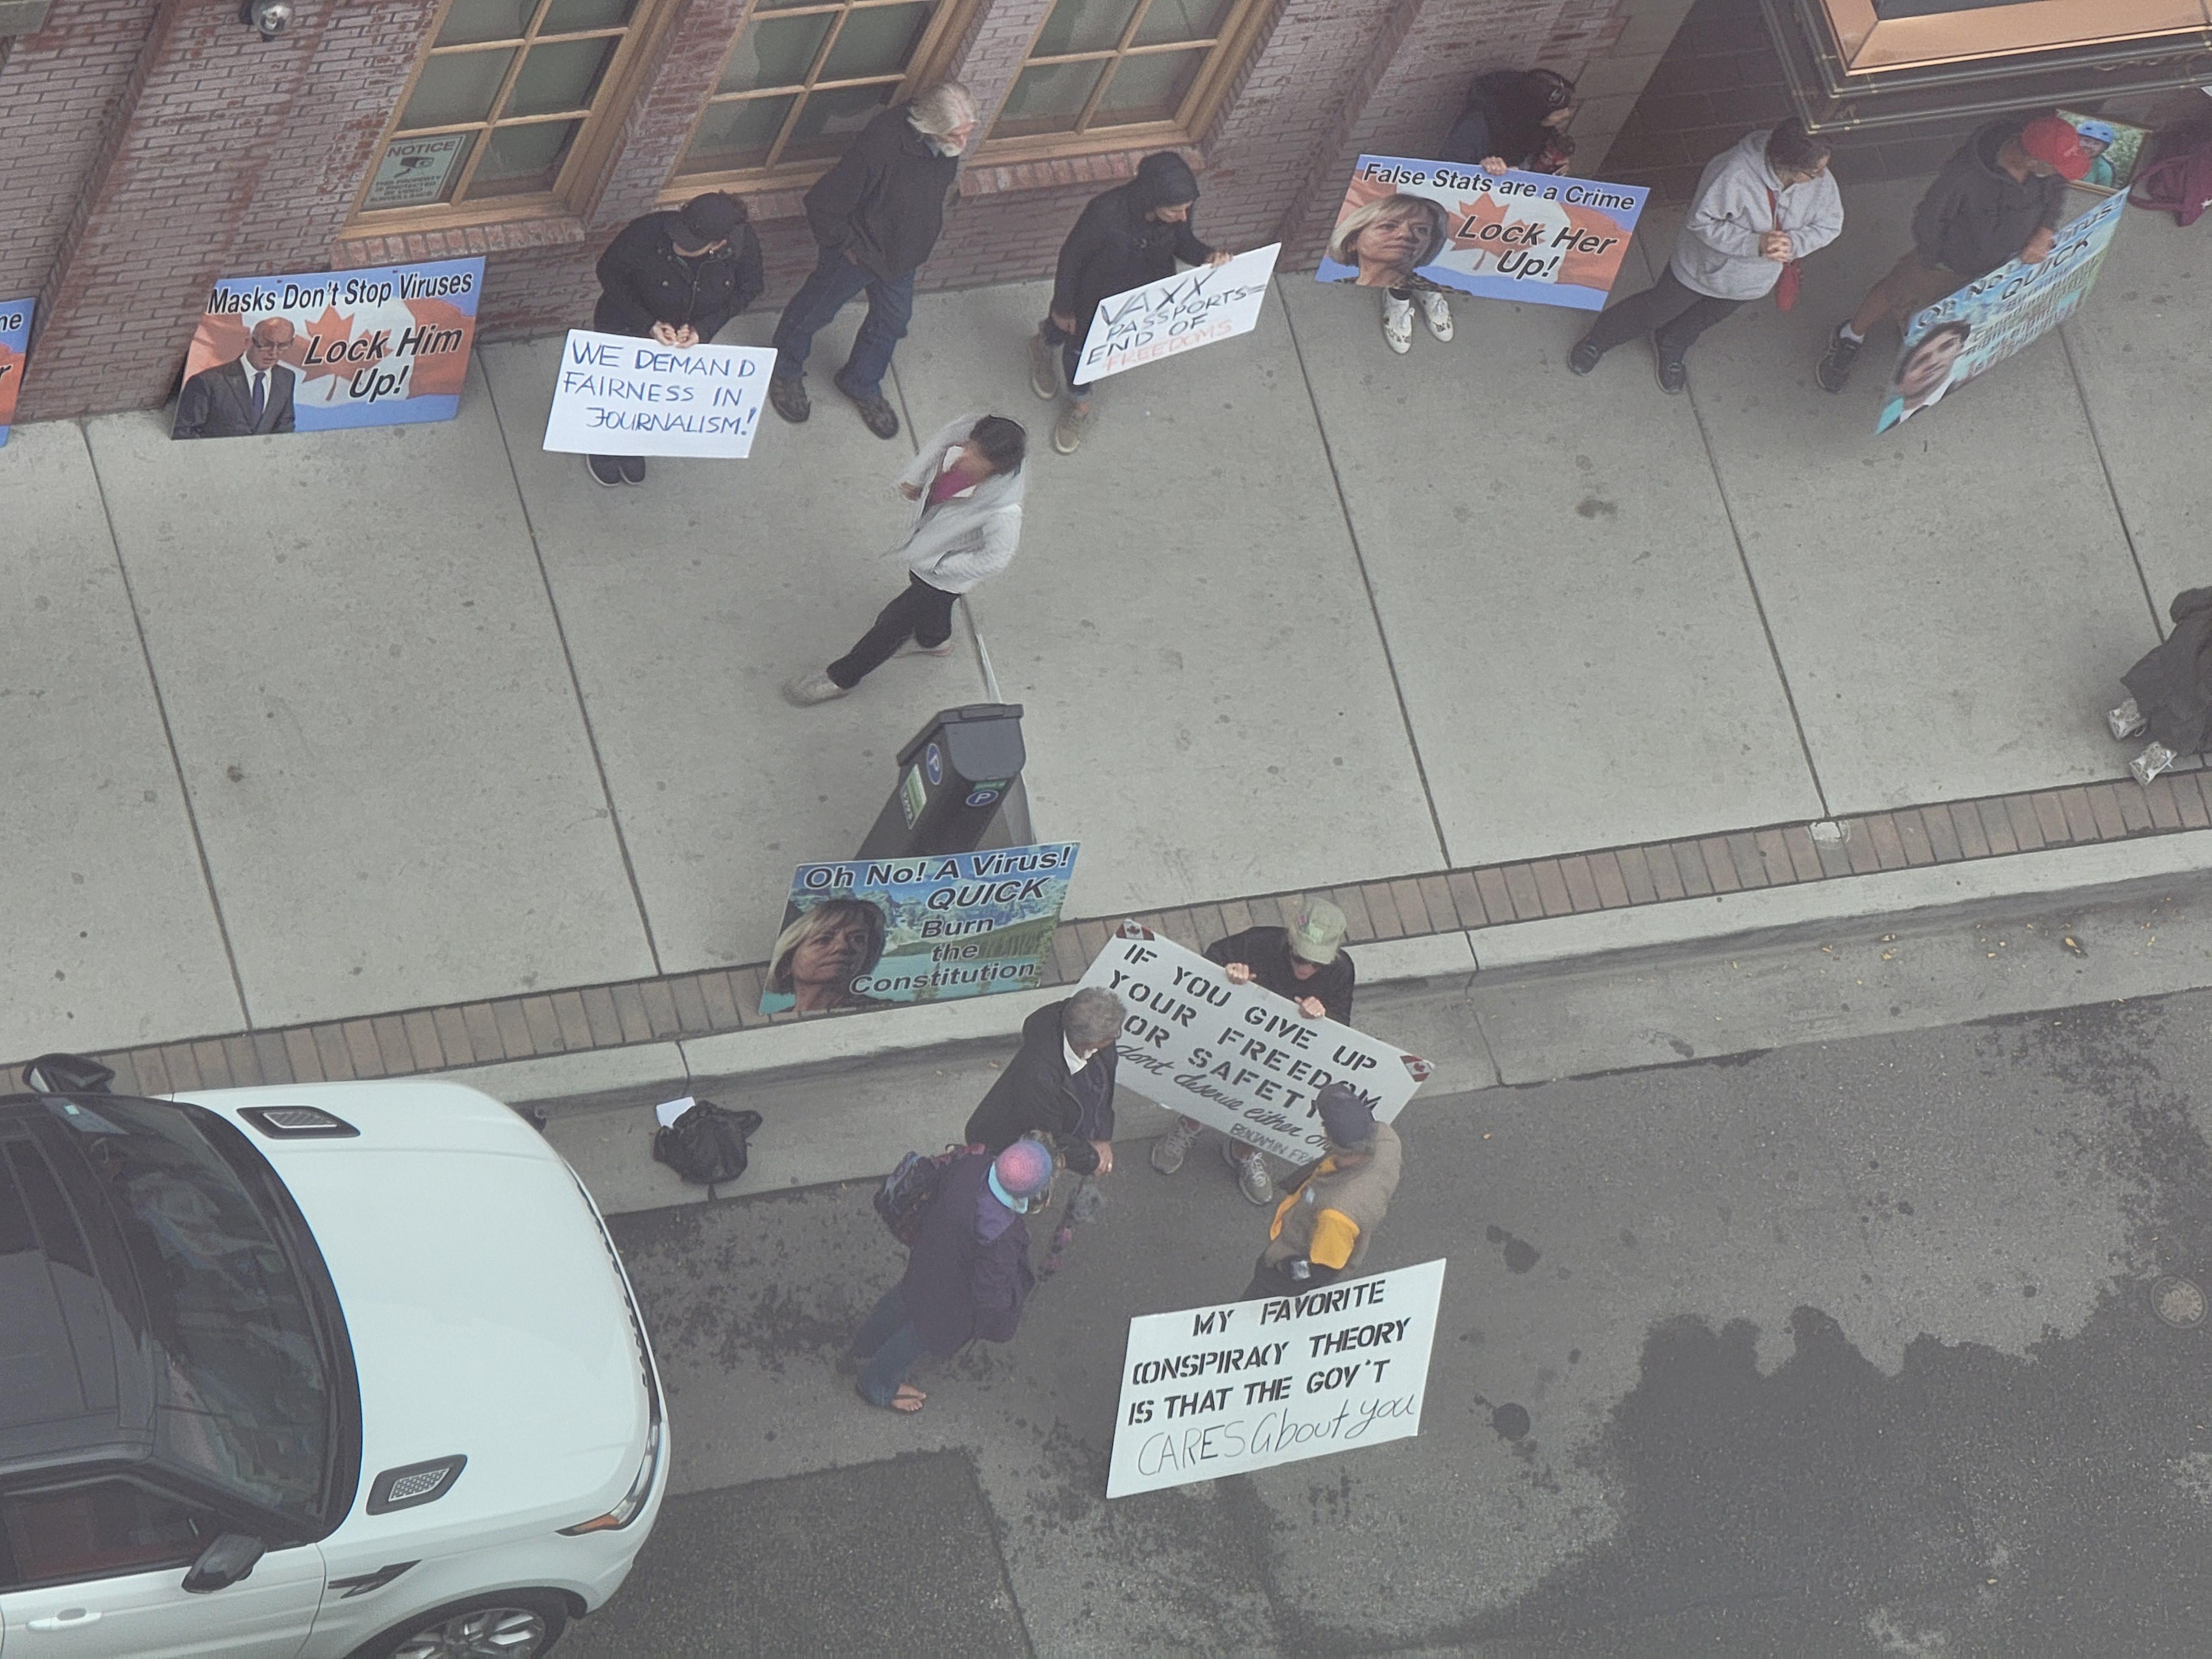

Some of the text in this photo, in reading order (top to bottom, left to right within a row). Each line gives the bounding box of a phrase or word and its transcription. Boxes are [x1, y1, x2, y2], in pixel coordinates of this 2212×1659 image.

[387, 140, 455, 157] NOTICE
[1363, 163, 1635, 211] False Stats are a Crime
[1456, 215, 1618, 255] Lock Her
[1496, 250, 1560, 280] Up!
[2001, 229, 2094, 301] QUICK
[208, 273, 473, 314] Masks Don't Stop Viruses
[304, 325, 462, 365] Lock Him
[572, 338, 755, 378] WE DEMAND
[1086, 314, 1208, 366] END OF
[1104, 319, 1233, 372] FREEDOMS
[348, 365, 409, 403] Up!
[562, 372, 743, 407] FAIRNESS IN
[586, 406, 758, 435] JOURNALISM!
[804, 846, 1071, 888] Oh No! A Virus!
[927, 877, 1050, 910] QUICK
[921, 918, 993, 938] Burn
[932, 943, 978, 962] the
[850, 962, 1035, 993] Constitution
[1124, 943, 1378, 1071] IF YOU GIVE UP
[1109, 969, 1383, 1111] YOUR FREEDM
[1173, 1073, 1244, 1111] deserve
[1244, 1108, 1304, 1137] either
[1192, 1279, 1386, 1337] MY FAVORITE
[1132, 1317, 1412, 1385] CONSPIRACY THEORY
[1128, 1359, 1391, 1426] IS THAT THE GOV'T
[1138, 1420, 1246, 1476] CARES
[1344, 1394, 1416, 1439] you
